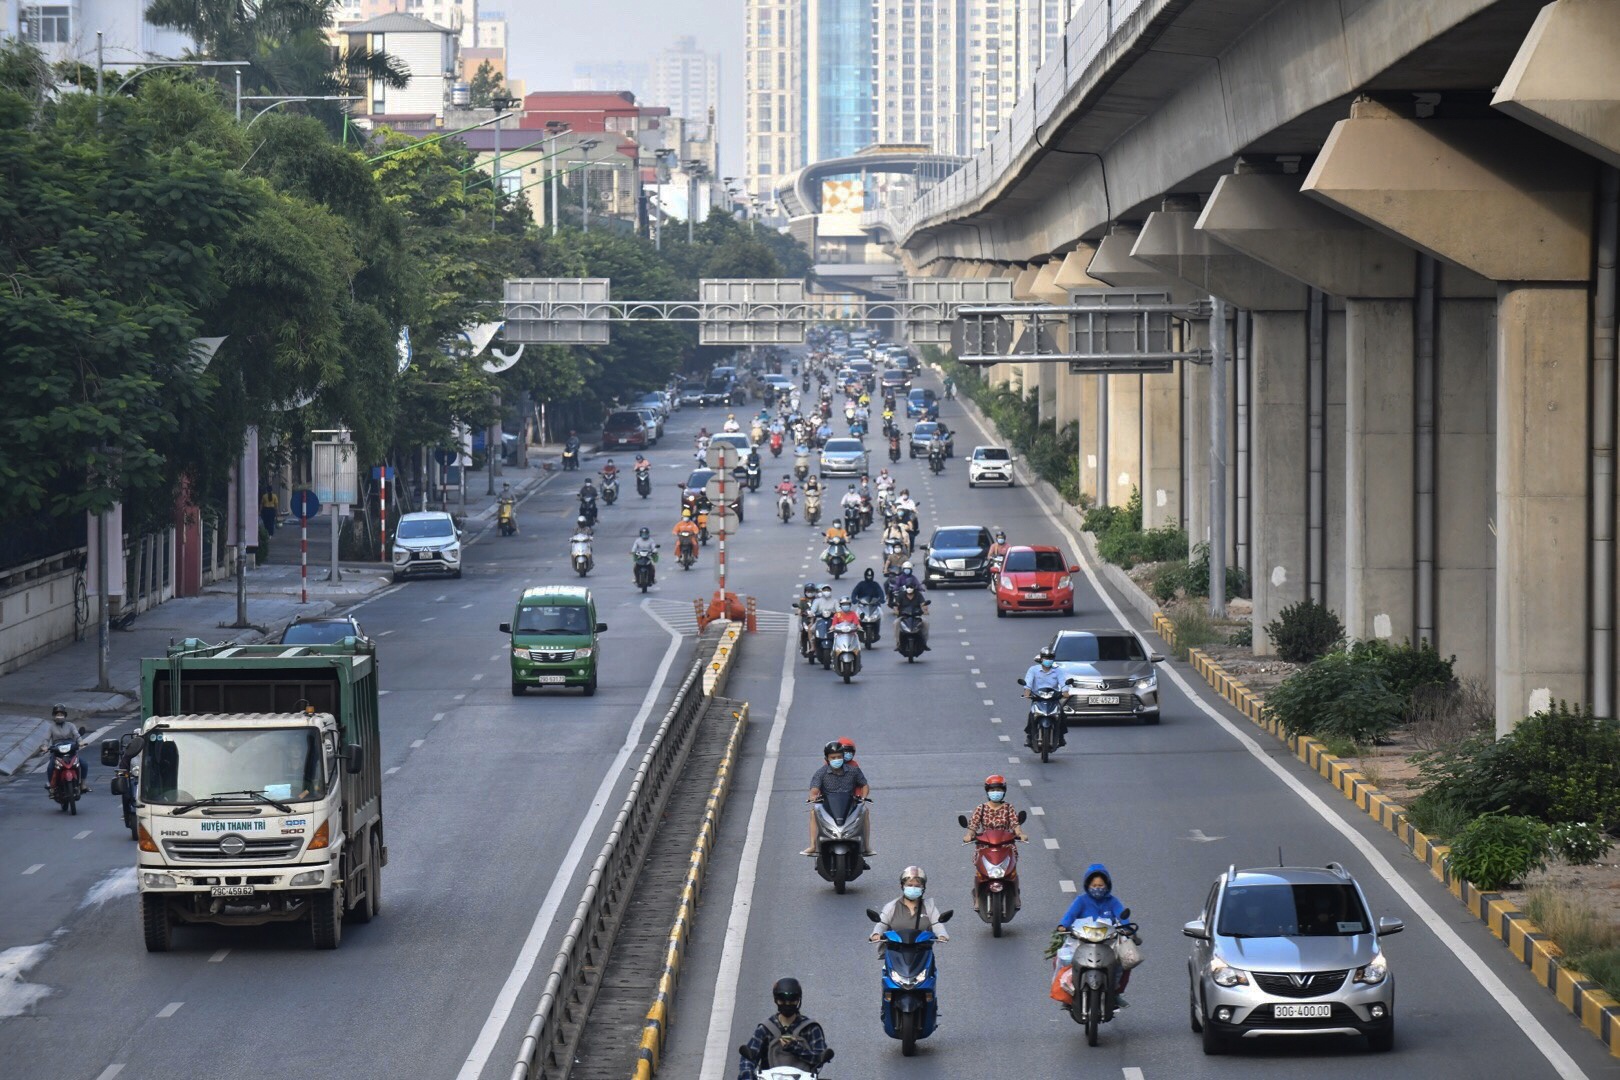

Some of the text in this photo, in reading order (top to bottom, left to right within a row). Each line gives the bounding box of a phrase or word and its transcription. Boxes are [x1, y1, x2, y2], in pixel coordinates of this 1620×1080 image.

[201, 819, 266, 832] HUYỆN THANH TRÌ
